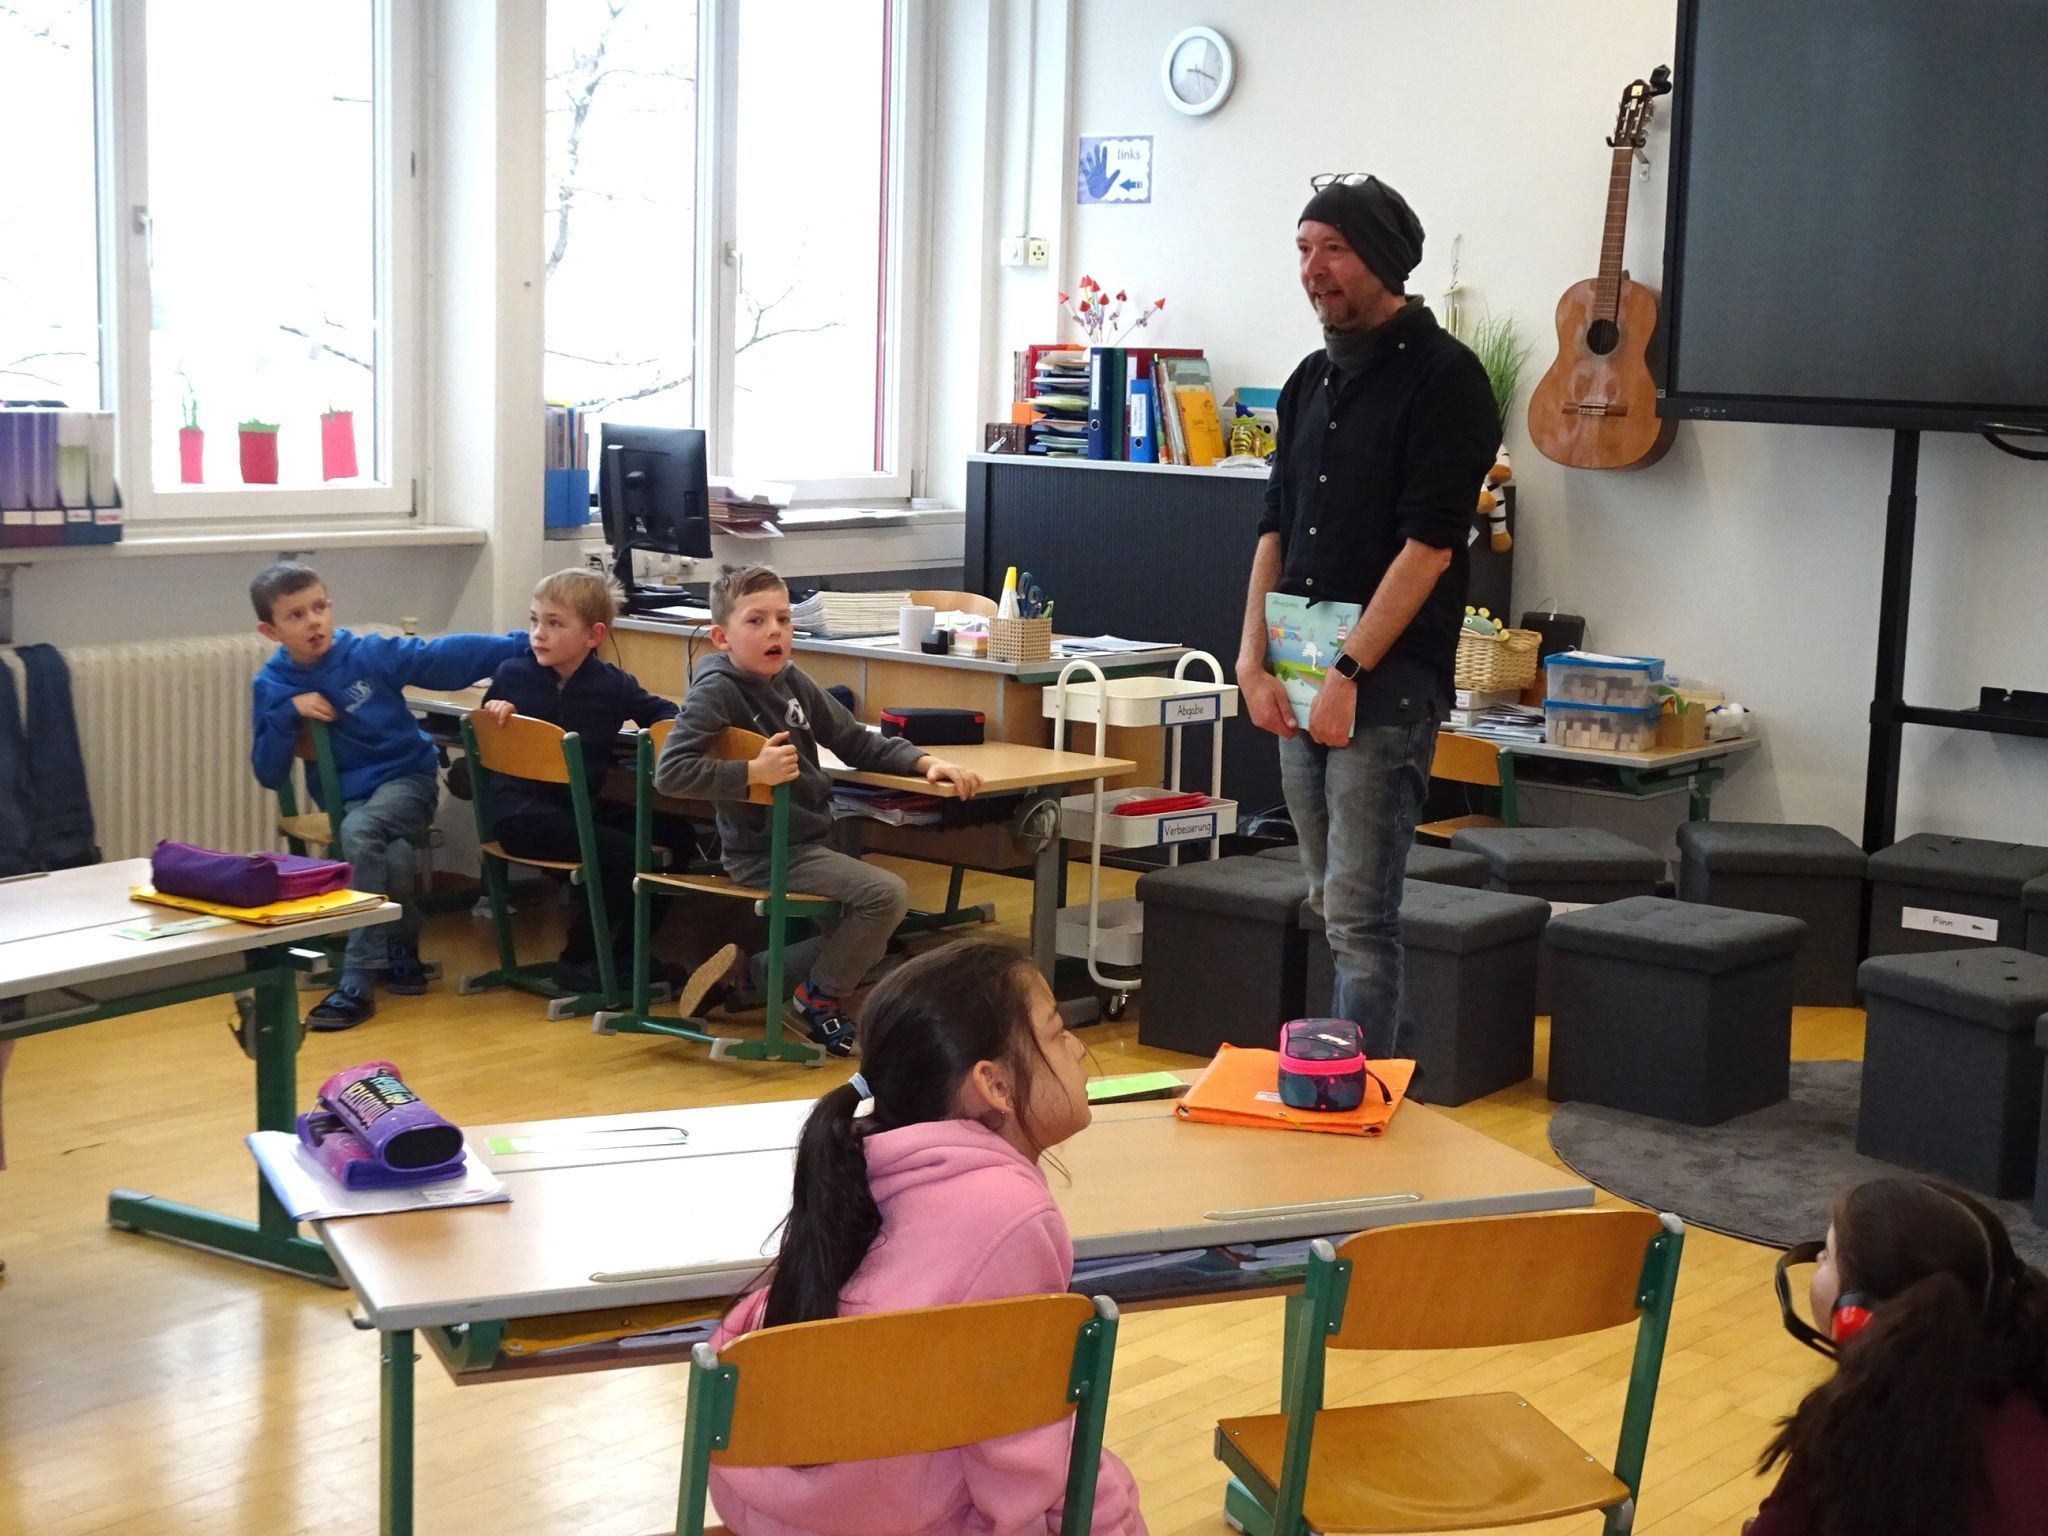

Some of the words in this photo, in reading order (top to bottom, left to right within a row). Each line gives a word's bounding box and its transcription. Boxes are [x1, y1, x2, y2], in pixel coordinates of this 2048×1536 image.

[1117, 147, 1141, 160] links
[1177, 704, 1204, 719] Abgabe
[1164, 822, 1212, 836] Verbesserung
[1933, 915, 1953, 926] Finn
